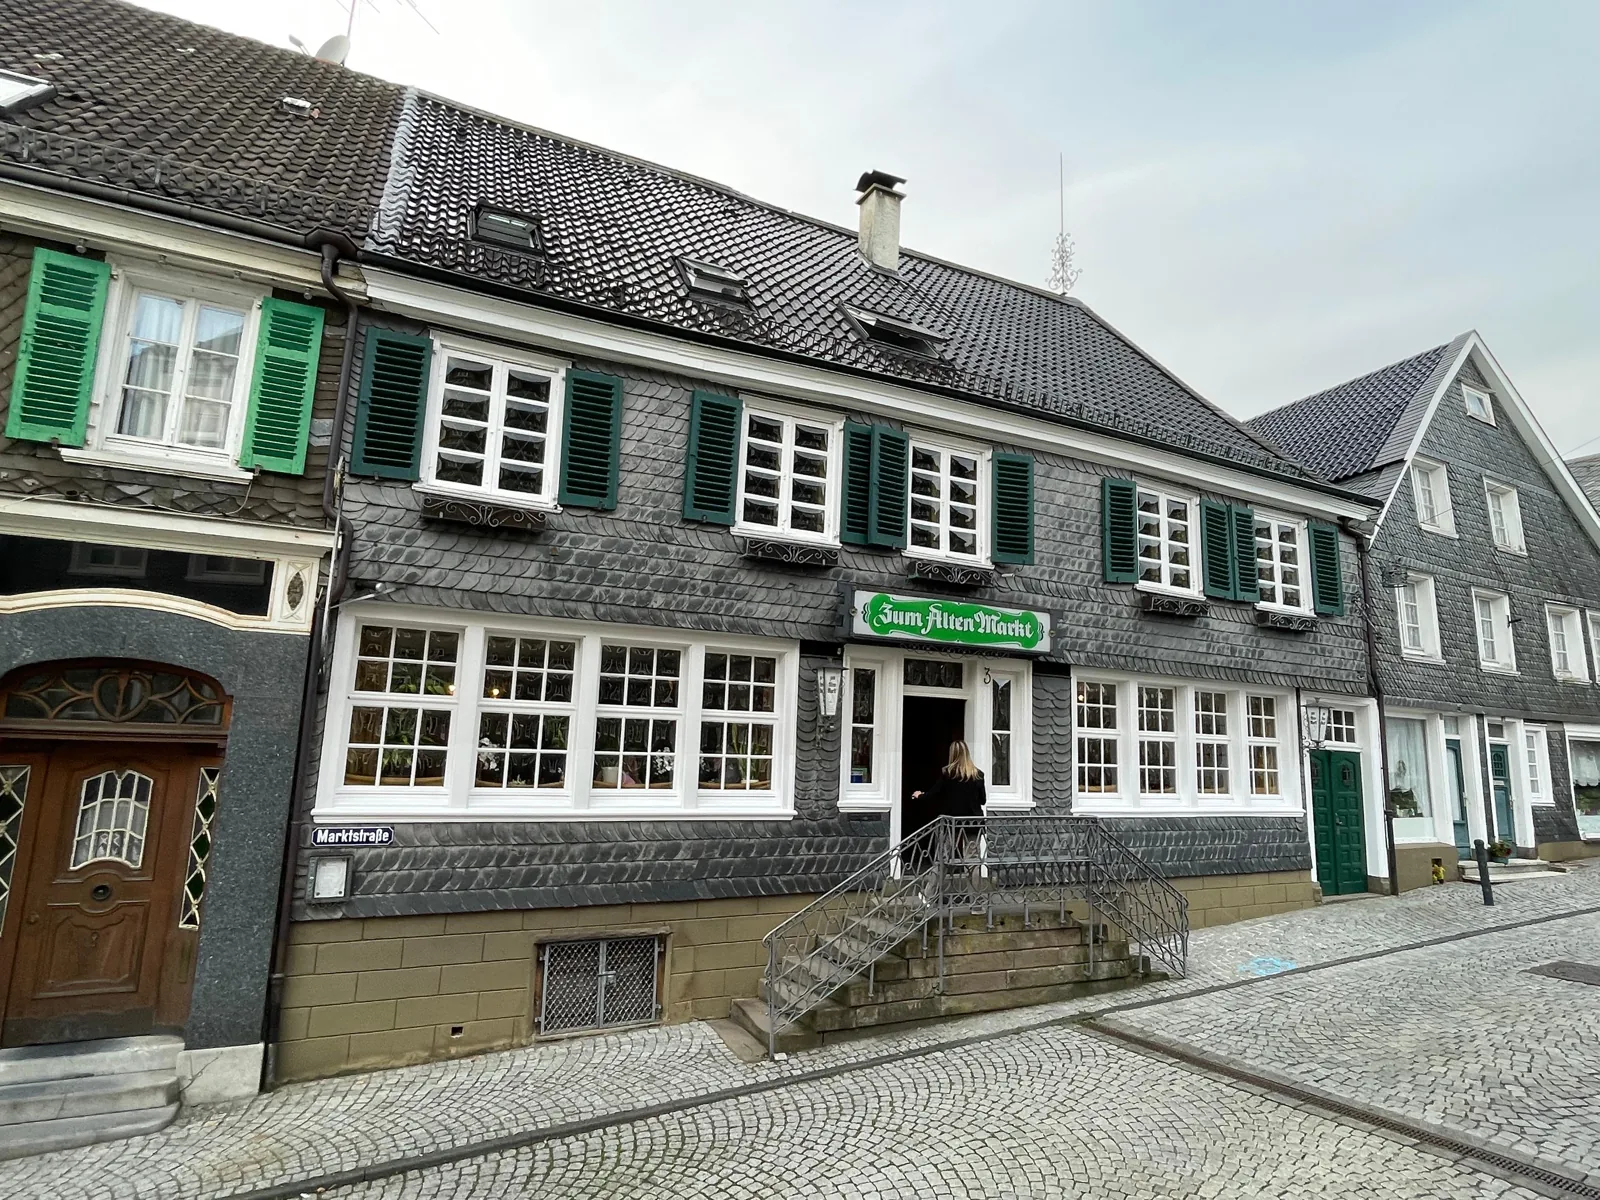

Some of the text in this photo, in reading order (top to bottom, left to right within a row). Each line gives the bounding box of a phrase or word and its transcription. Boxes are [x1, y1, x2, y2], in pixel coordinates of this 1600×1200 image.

[873, 601, 1035, 639] Zum Alten Markt
[983, 667, 992, 685] 3
[316, 828, 389, 844] Marktstraße
